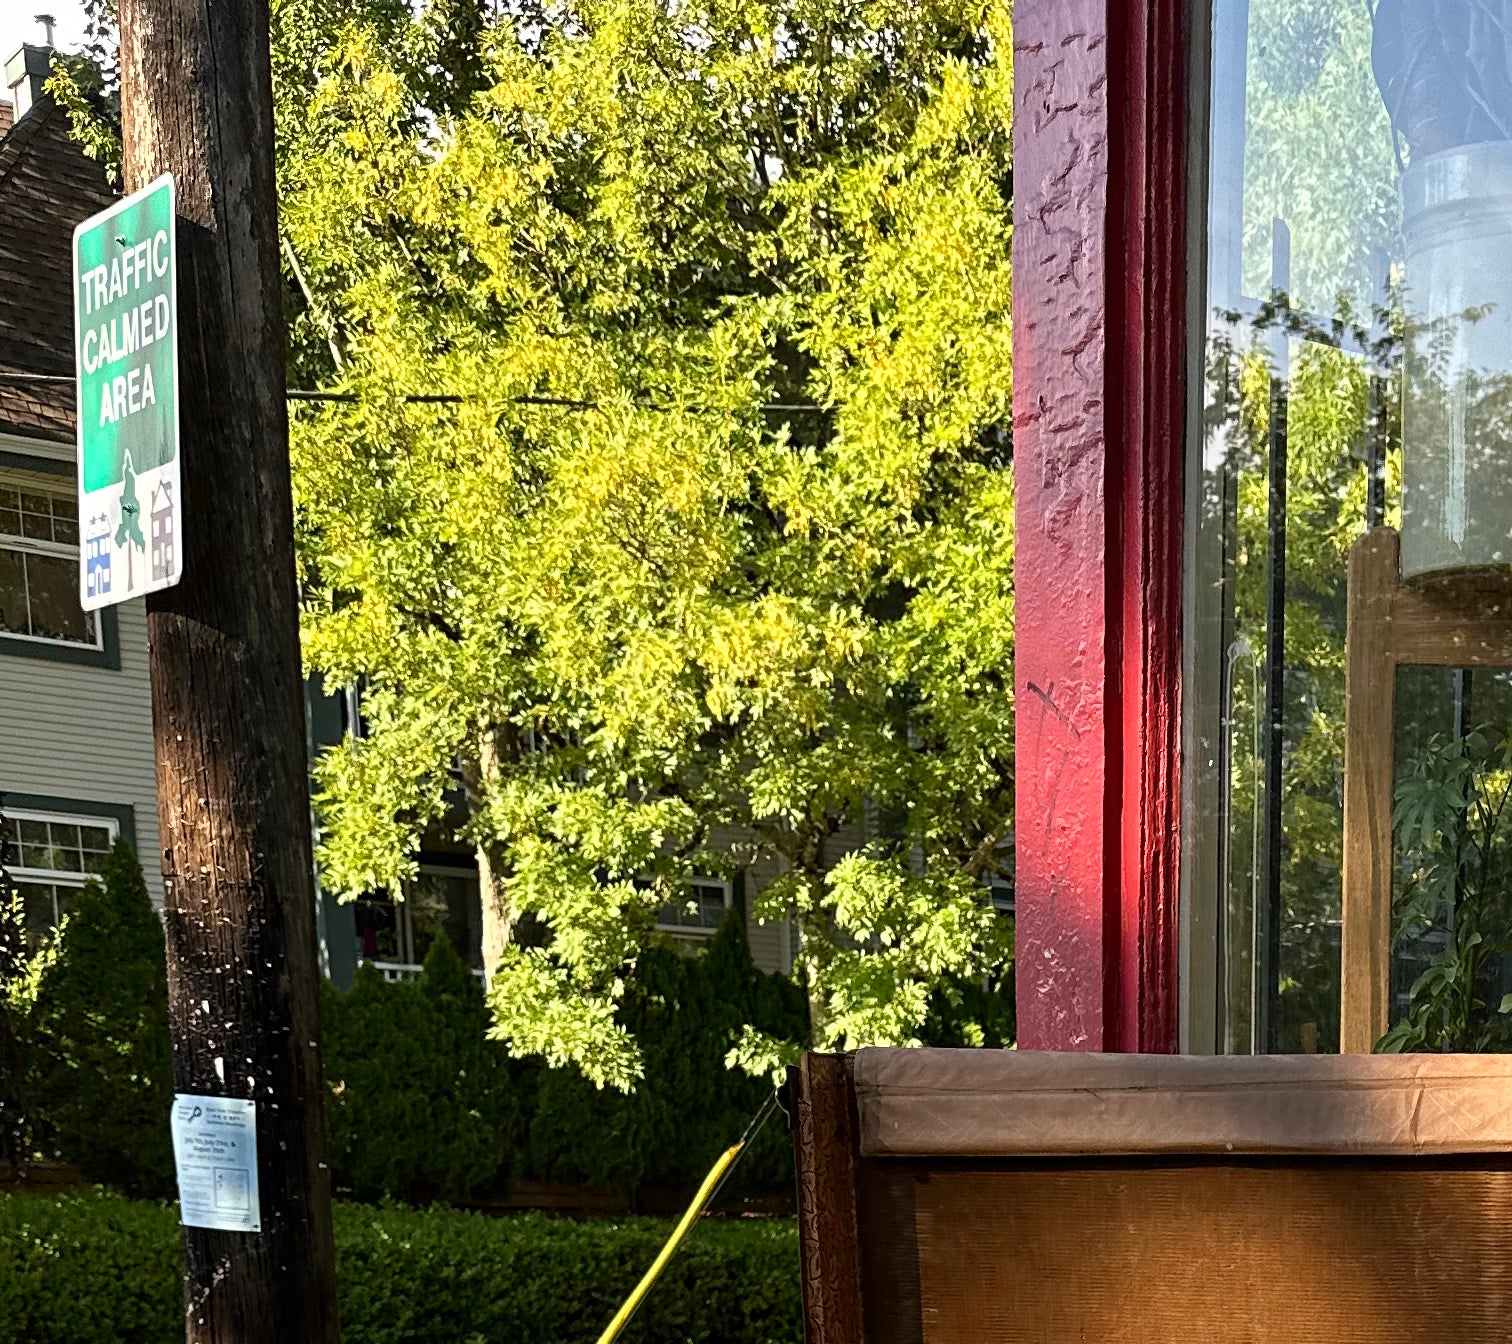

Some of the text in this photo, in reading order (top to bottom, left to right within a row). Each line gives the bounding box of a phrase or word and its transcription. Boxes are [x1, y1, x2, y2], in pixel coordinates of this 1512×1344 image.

[82, 230, 168, 315] TRAFFIC
[83, 294, 169, 375] CALMED
[100, 363, 156, 427] AREA
